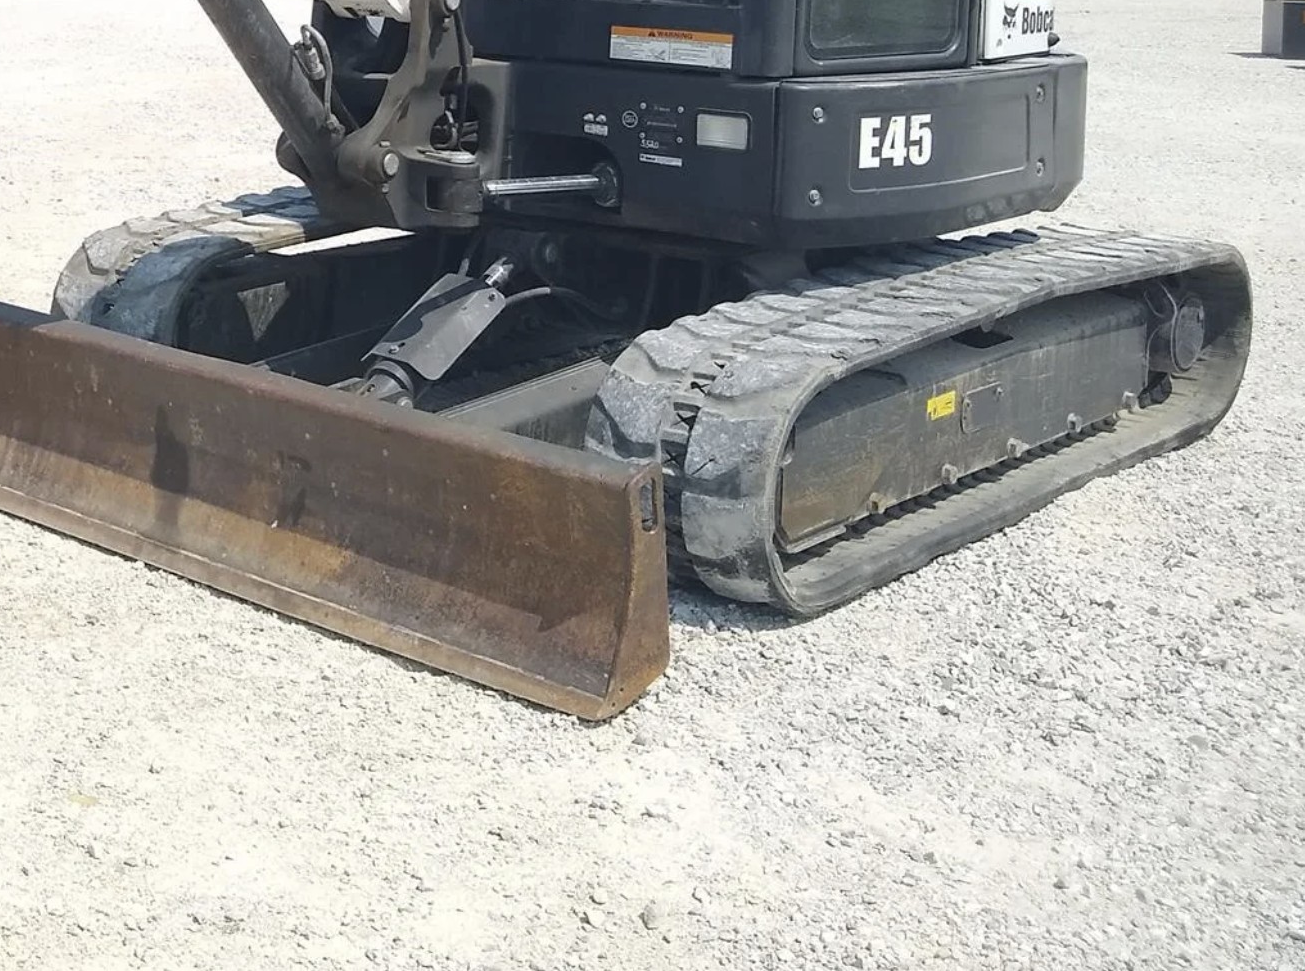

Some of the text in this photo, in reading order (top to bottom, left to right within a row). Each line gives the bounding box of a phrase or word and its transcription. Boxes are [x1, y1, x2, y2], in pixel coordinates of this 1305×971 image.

[657, 30, 693, 40] WARNING
[1022, 5, 1055, 35] Bobca
[858, 113, 932, 169] E45
